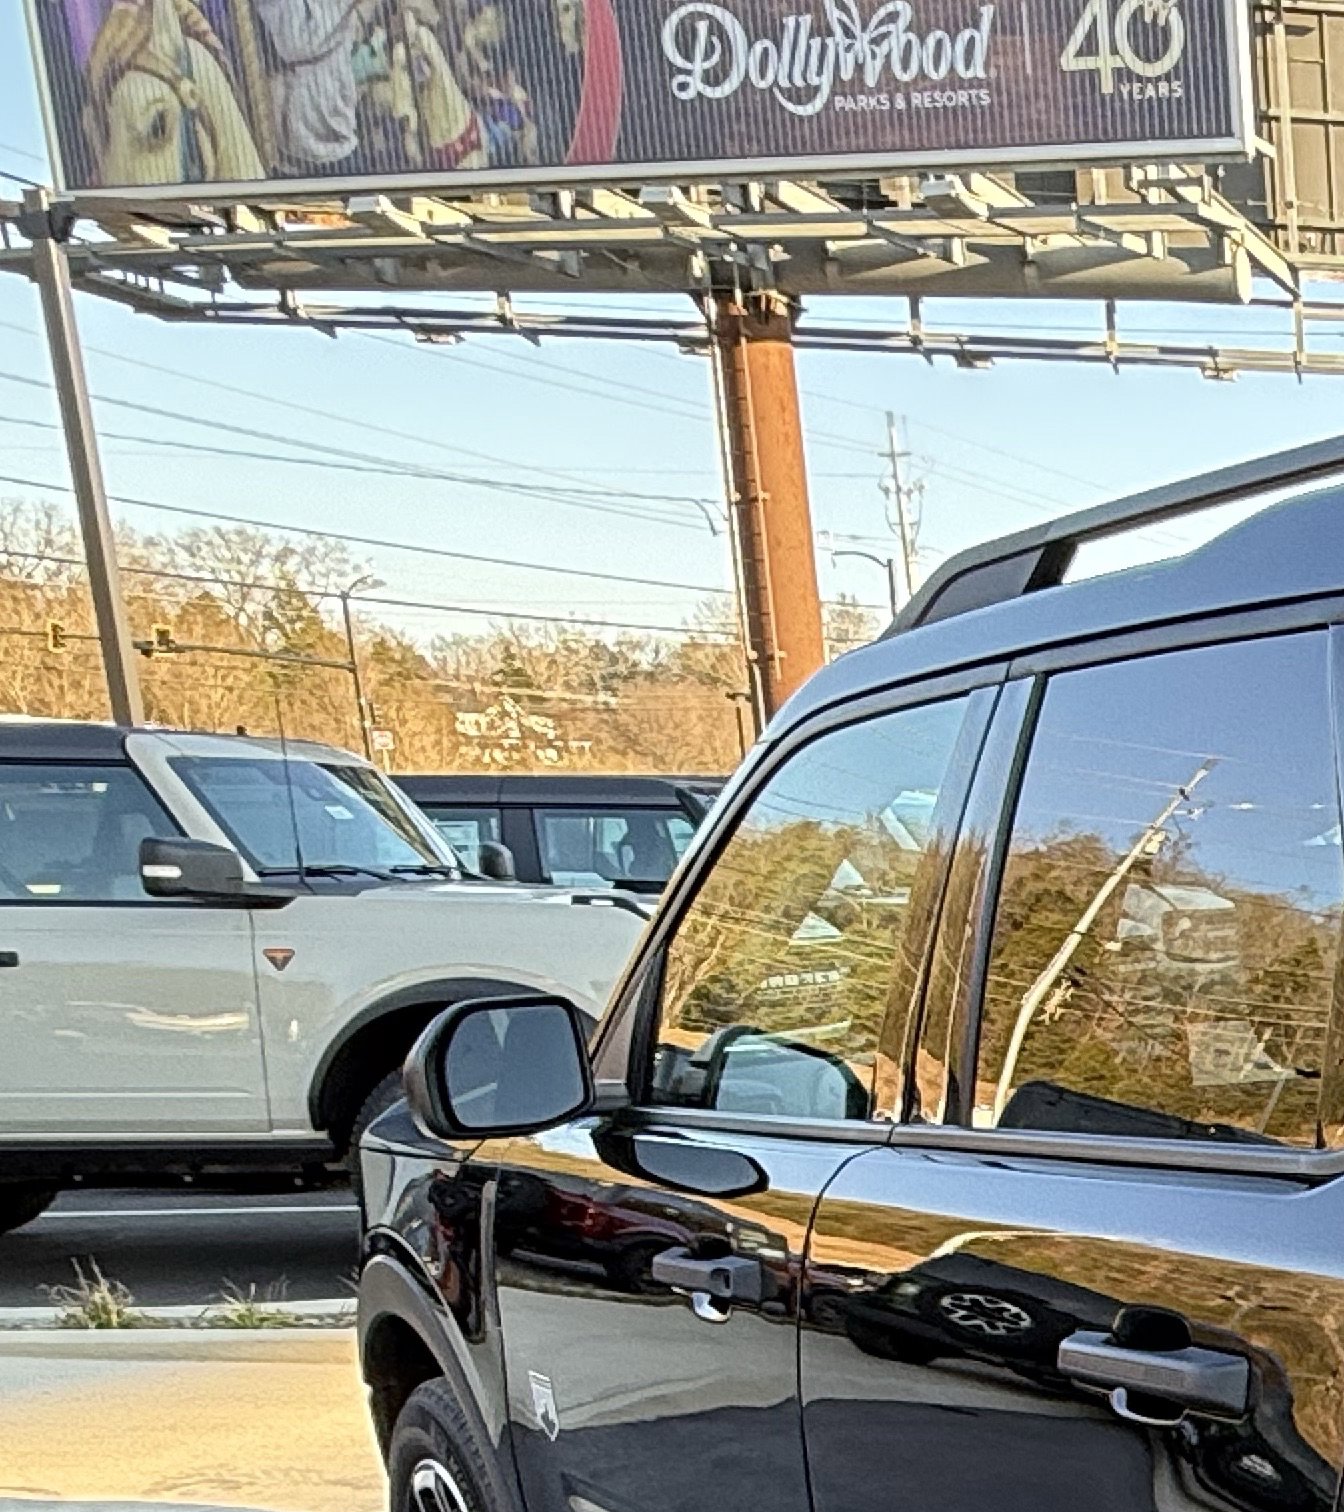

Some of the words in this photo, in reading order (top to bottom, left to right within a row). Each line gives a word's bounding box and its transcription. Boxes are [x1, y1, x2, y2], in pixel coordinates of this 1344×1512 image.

[1061, 0, 1184, 94] 40
[834, 94, 890, 111] PARKS
[894, 92, 906, 109] &
[911, 88, 991, 108] RESORTS
[1119, 81, 1183, 100] YEARS
